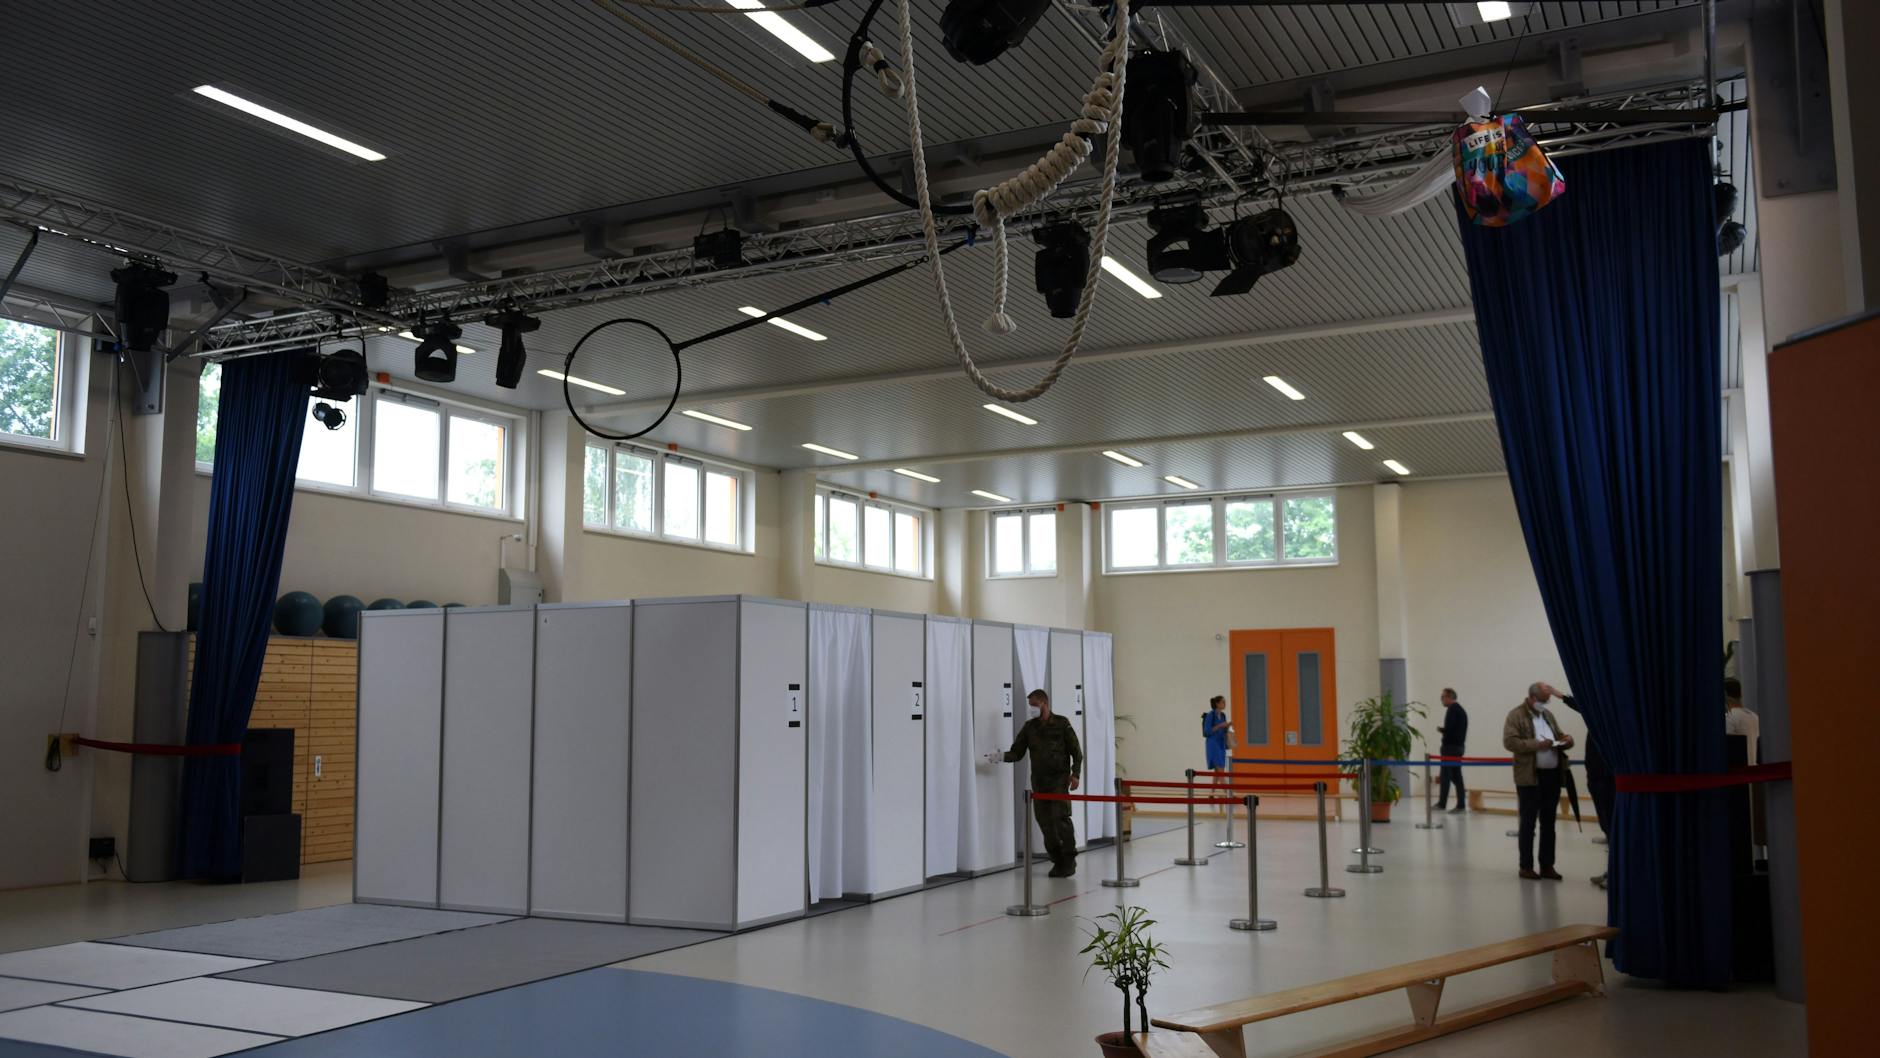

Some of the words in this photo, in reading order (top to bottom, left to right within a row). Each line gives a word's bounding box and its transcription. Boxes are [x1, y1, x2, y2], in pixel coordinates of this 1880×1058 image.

[1469, 134, 1490, 148] LIFE
[1492, 130, 1502, 139] IS
[792, 696, 798, 712] 1
[914, 693, 920, 706] 2
